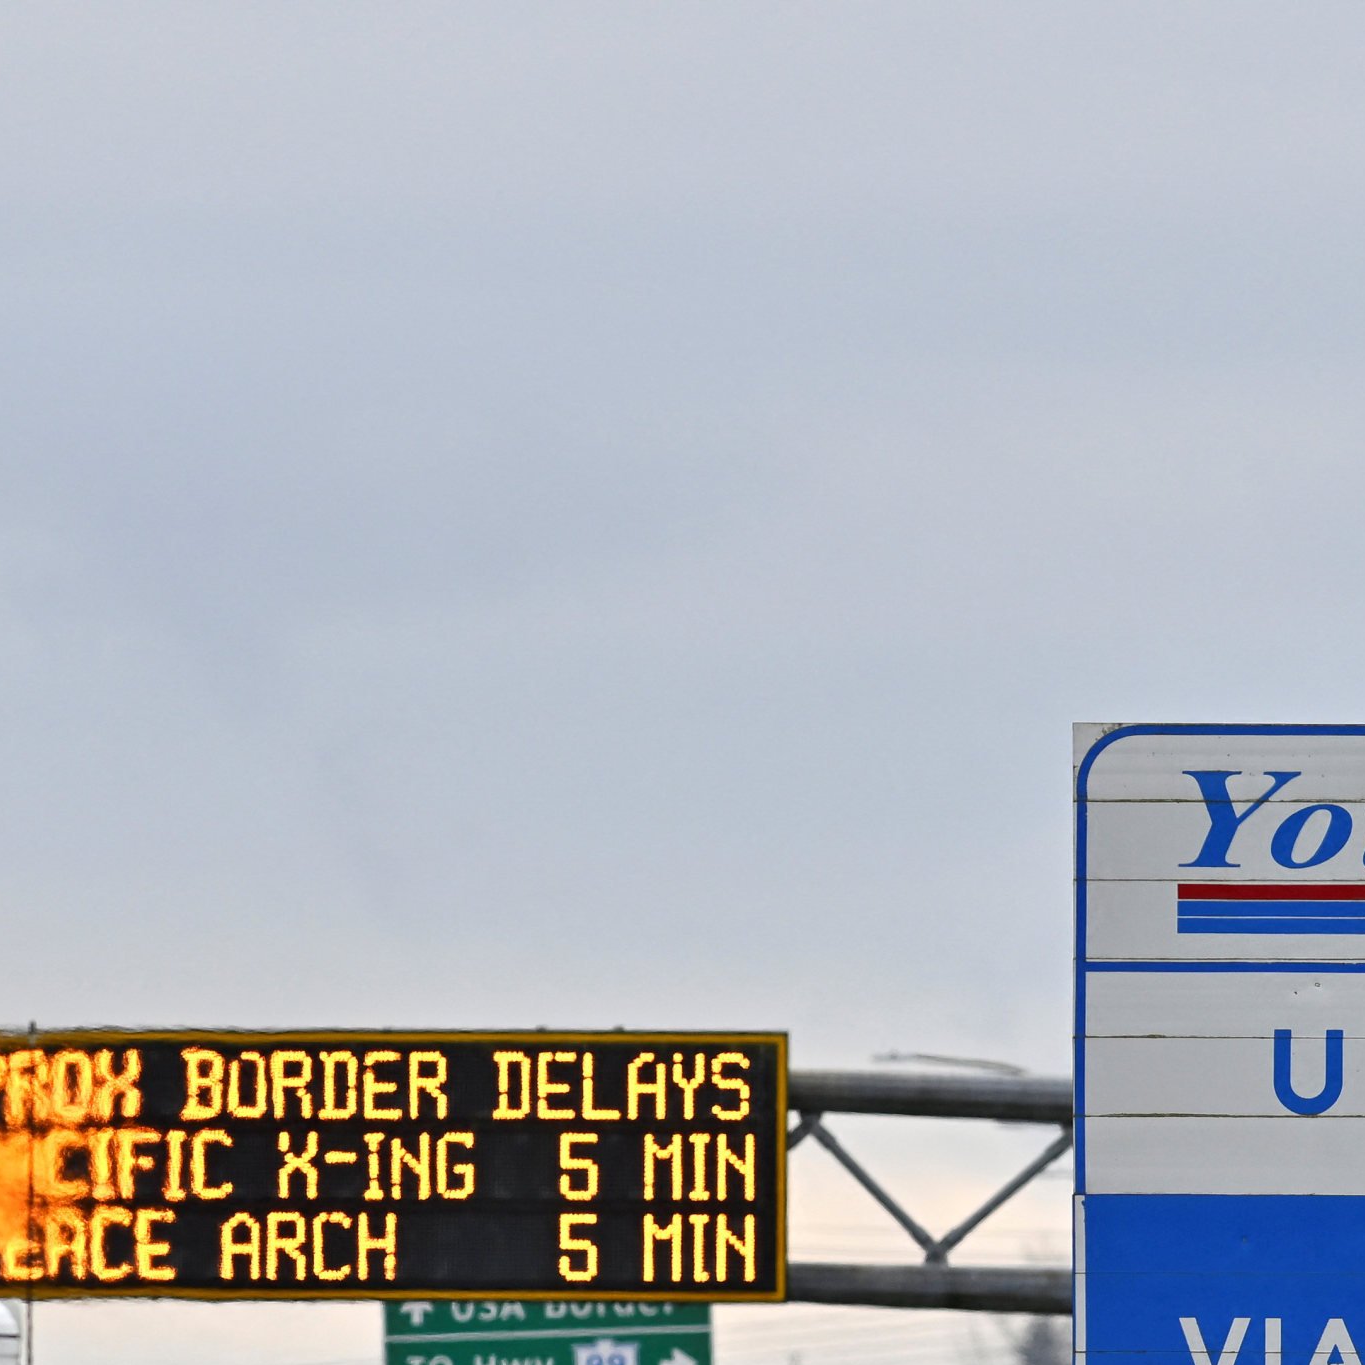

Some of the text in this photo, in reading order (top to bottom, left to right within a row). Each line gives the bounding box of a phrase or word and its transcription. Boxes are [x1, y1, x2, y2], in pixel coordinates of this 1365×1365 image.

[180, 1048, 448, 1121] BORDER
[492, 1051, 751, 1121] DELAYS
[278, 1130, 474, 1202] X-ING
[559, 1132, 599, 1202] 5
[643, 1132, 756, 1202] MIN
[219, 1211, 398, 1282] ARCH
[558, 1213, 598, 1283] 5
[643, 1213, 756, 1283] MIN
